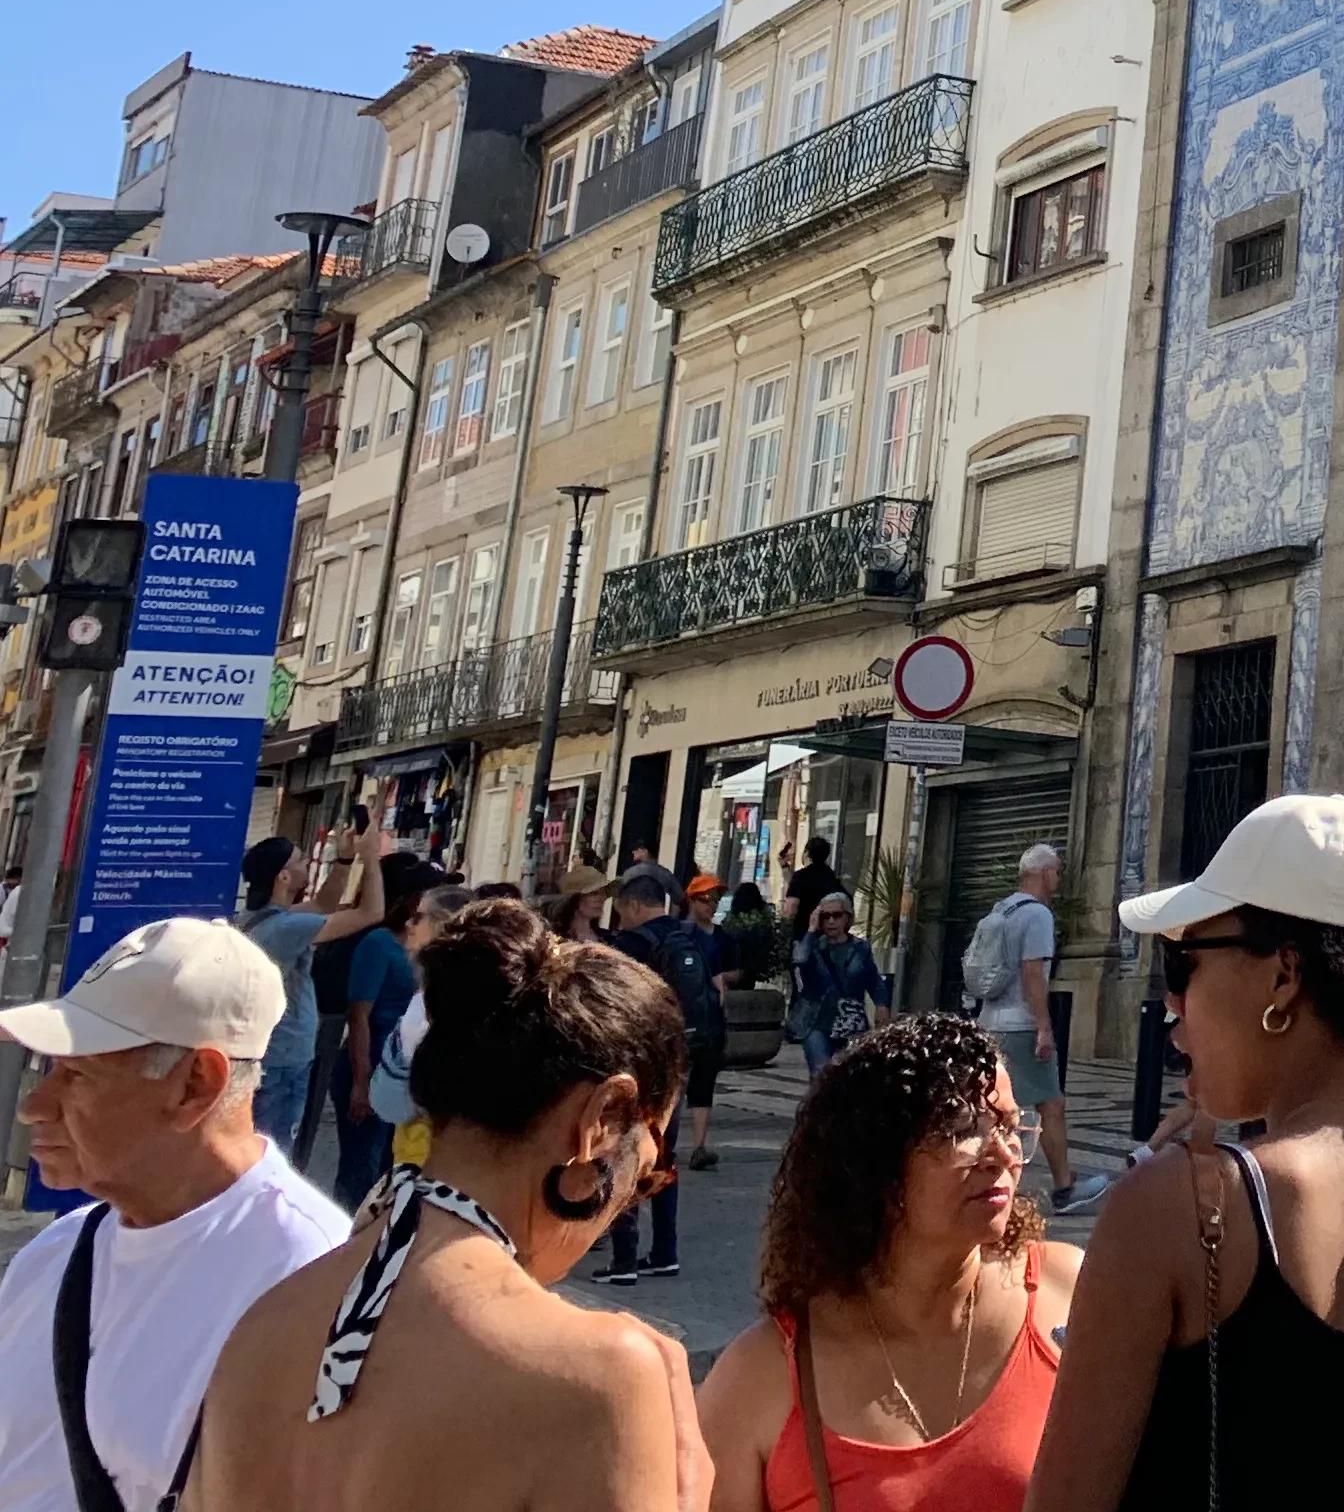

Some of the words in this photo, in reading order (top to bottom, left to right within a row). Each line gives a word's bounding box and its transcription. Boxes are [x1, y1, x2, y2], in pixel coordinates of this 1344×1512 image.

[153, 521, 222, 540] SANTA
[150, 545, 256, 566] CATARINA
[145, 575, 176, 585] ZONA
[177, 577, 193, 586] DE
[194, 578, 238, 588] ACESSO
[143, 587, 210, 599] AUTOMÓVEL
[141, 600, 229, 613] CONDICIONADO
[235, 605, 265, 614] ZAAC
[139, 614, 192, 624] RESTRICTED
[193, 616, 216, 624] AREA
[137, 624, 193, 634] AUTHORIZED
[238, 628, 260, 637] ONLY
[132, 664, 256, 685] ATENÇÃO!
[133, 690, 245, 706] ATTENTION!
[758, 677, 819, 707] FUNERÁRIA
[118, 735, 165, 745] REGISTO
[166, 736, 239, 747] OBRIGATÓRIO
[113, 768, 159, 778] Posicione
[171, 782, 186, 790] via
[103, 824, 144, 834] Aguarde
[101, 836, 128, 845] verde
[95, 870, 152, 879] Velocidade
[153, 870, 193, 879] Máxima
